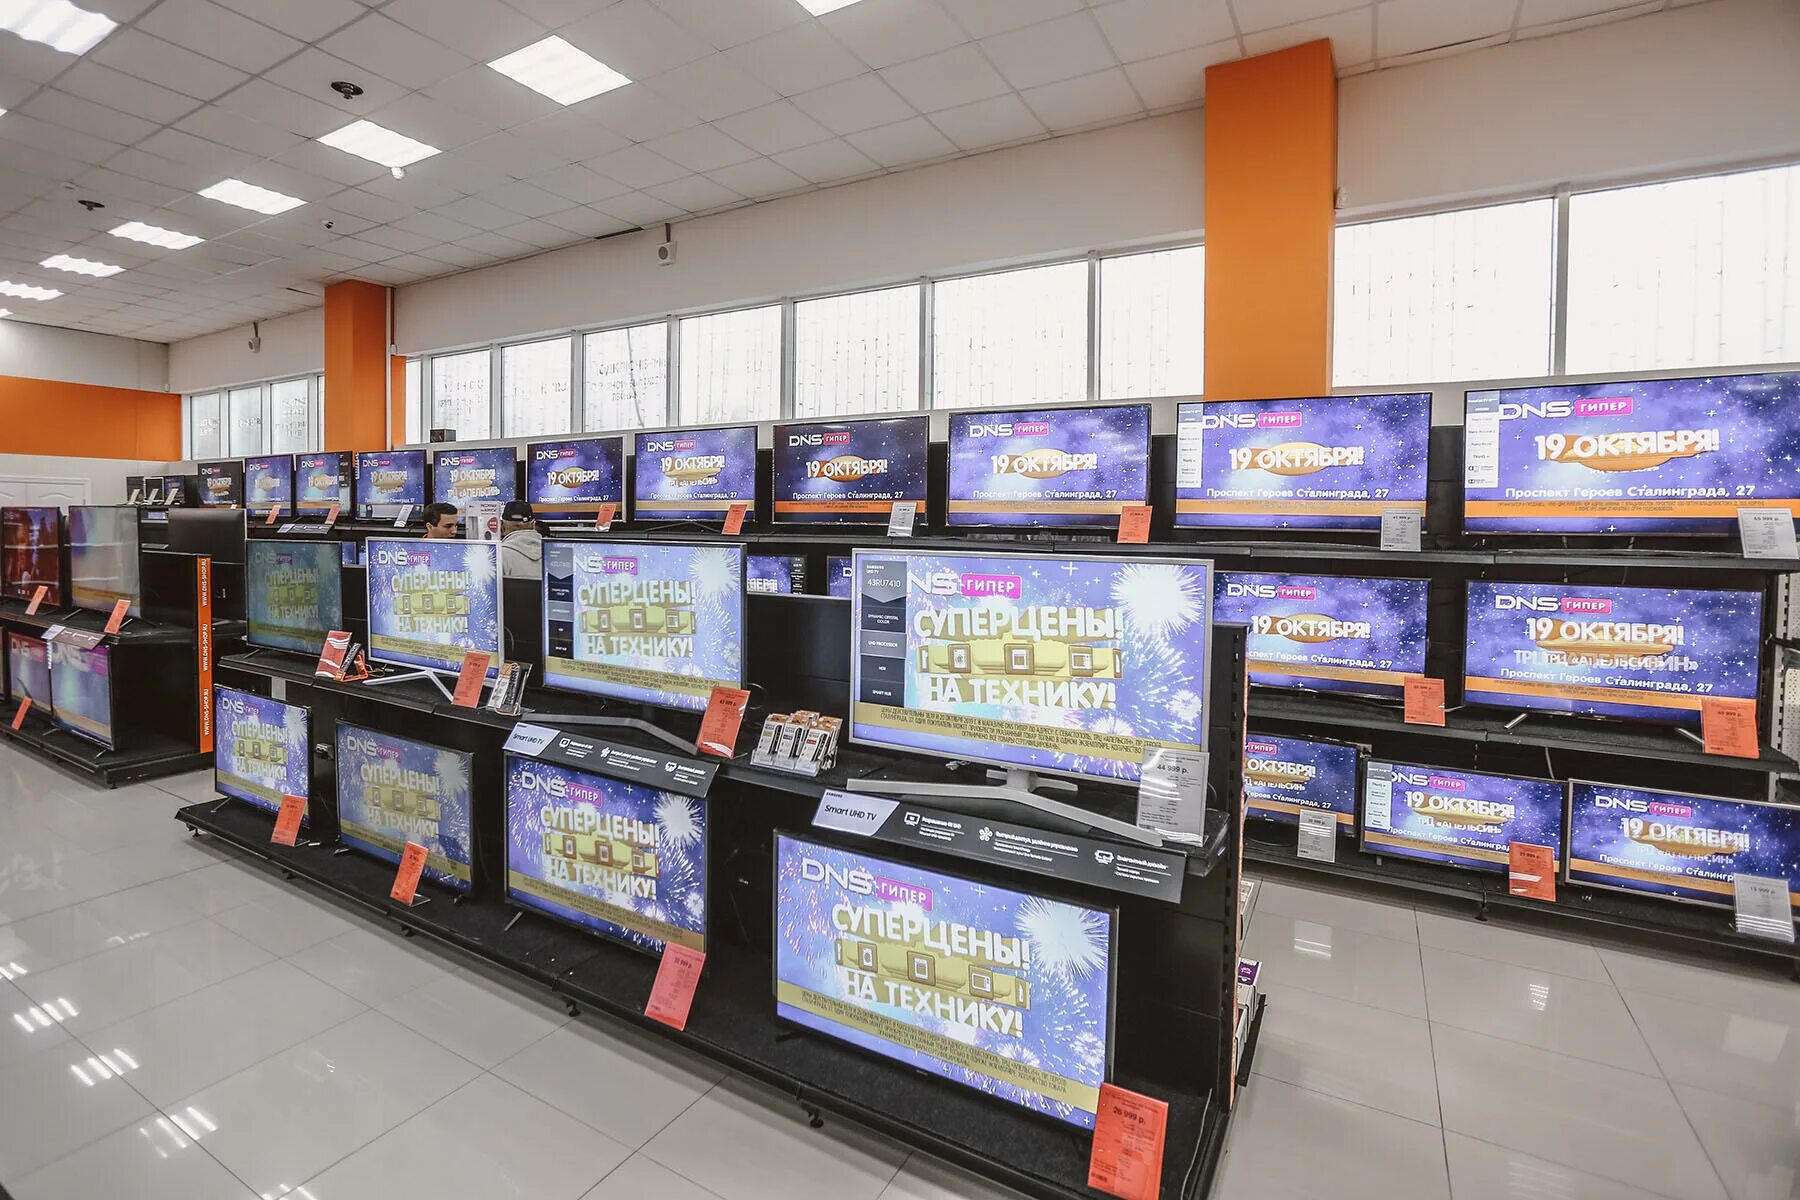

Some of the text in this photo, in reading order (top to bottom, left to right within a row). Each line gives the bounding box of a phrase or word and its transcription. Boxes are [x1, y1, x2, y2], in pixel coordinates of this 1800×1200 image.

[1500, 401, 1627, 420] DNS ГИПЕР
[969, 424, 1045, 437] DNS ГИПЕР
[1202, 413, 1297, 430] DNS ГИПЕР
[648, 441, 674, 452] DNS
[789, 434, 822, 446] DNS
[1534, 429, 1720, 460] 19 ОКТЯБРЯ!
[441, 457, 460, 466] DNS
[536, 450, 558, 460] DNS
[660, 456, 725, 472] 19 ОКТЯБРЯ!
[991, 453, 1098, 474] 19 ОКТЯБРЯ!
[1229, 446, 1364, 469] 19 ОКТЯБРЯ!
[450, 469, 495, 482] 19 ОКТЯБРЯ!
[806, 459, 887, 477] 19 ОКТЯБРЯ!
[547, 470, 599, 485] 19 ОКТЯБРЯ!
[793, 492, 822, 500] Проспект
[823, 492, 846, 500] Героев
[848, 491, 892, 500] Сталинграда,
[1207, 488, 1390, 499] Проспект Героев Сталинграда, 27
[1505, 485, 1755, 500] Проспект Героев Сталинграда, 27
[378, 550, 428, 565] DNS ГИПЕР
[607, 560, 634, 571] ГИПЕР
[391, 572, 469, 592] СУПЕРЦЕНЫ!
[868, 580, 901, 588] 43RU7410
[906, 571, 1015, 595] NS ГИПЕР
[1227, 583, 1312, 598] DNS ГИПЕР
[578, 581, 696, 605] СУПЕРЦЕНЫ!
[1495, 595, 1606, 611] DNS ГИПЕР
[400, 616, 468, 633] НА ТЕХНИКУ!
[914, 606, 1124, 641] СУПЕРЦЕНЫ!
[1251, 615, 1371, 639] 19 ОКТЯБРЯ!
[1526, 618, 1685, 645] 19 ОКТЯБРЯ!
[586, 636, 693, 657] НА ТЕХНИКУ!
[1276, 652, 1392, 669] Героев Сталинграда, 27
[1500, 668, 1556, 681] Проспект
[1559, 672, 1601, 684] Героев
[1605, 675, 1692, 693] Сталинграда,
[1696, 682, 1713, 693] 27
[927, 678, 1115, 709] НА ТЕХНИКУ!
[222, 697, 244, 714] DNS
[232, 720, 288, 744] СУПЕРЦЕНЫ!
[513, 733, 527, 742] Smart
[347, 736, 399, 759] DNS ГИПЕР
[1250, 744, 1274, 752] ГИПЕР
[234, 758, 287, 781] НА ТЕХНИКУ!
[1247, 758, 1316, 777] ОКТЯБРЯ!
[361, 764, 440, 795] СУПЕРЦЕНЫ!
[522, 771, 598, 801] DNS ГИПЕР
[1433, 779, 1463, 788] ГИПЕР
[1272, 794, 1320, 808] Сталинграда,
[1405, 791, 1515, 818] 19 ОКТЯБРЯ!
[1595, 796, 1687, 814] DNS ГИПЕР
[825, 805, 878, 821] Smart UHD TV
[368, 807, 439, 838] НА ТЕХНИКУ!
[541, 806, 660, 848] СУПЕРЦЕНЫ!
[1387, 827, 1458, 843] Проспект Героев
[1621, 818, 1750, 851] 19 ОКТЯБРЯ!
[1600, 855, 1682, 873] Проспект Героев
[549, 858, 657, 900] НА ТЕХНИКУ!
[802, 857, 927, 903] DNS ГИПЕР
[832, 903, 1030, 970] СУПЕРЦЕНЫ!
[844, 970, 1023, 1038] НА ТЕХНИКУ!
[1113, 1106, 1123, 1116] 26
[1124, 1111, 1137, 1120] 999
